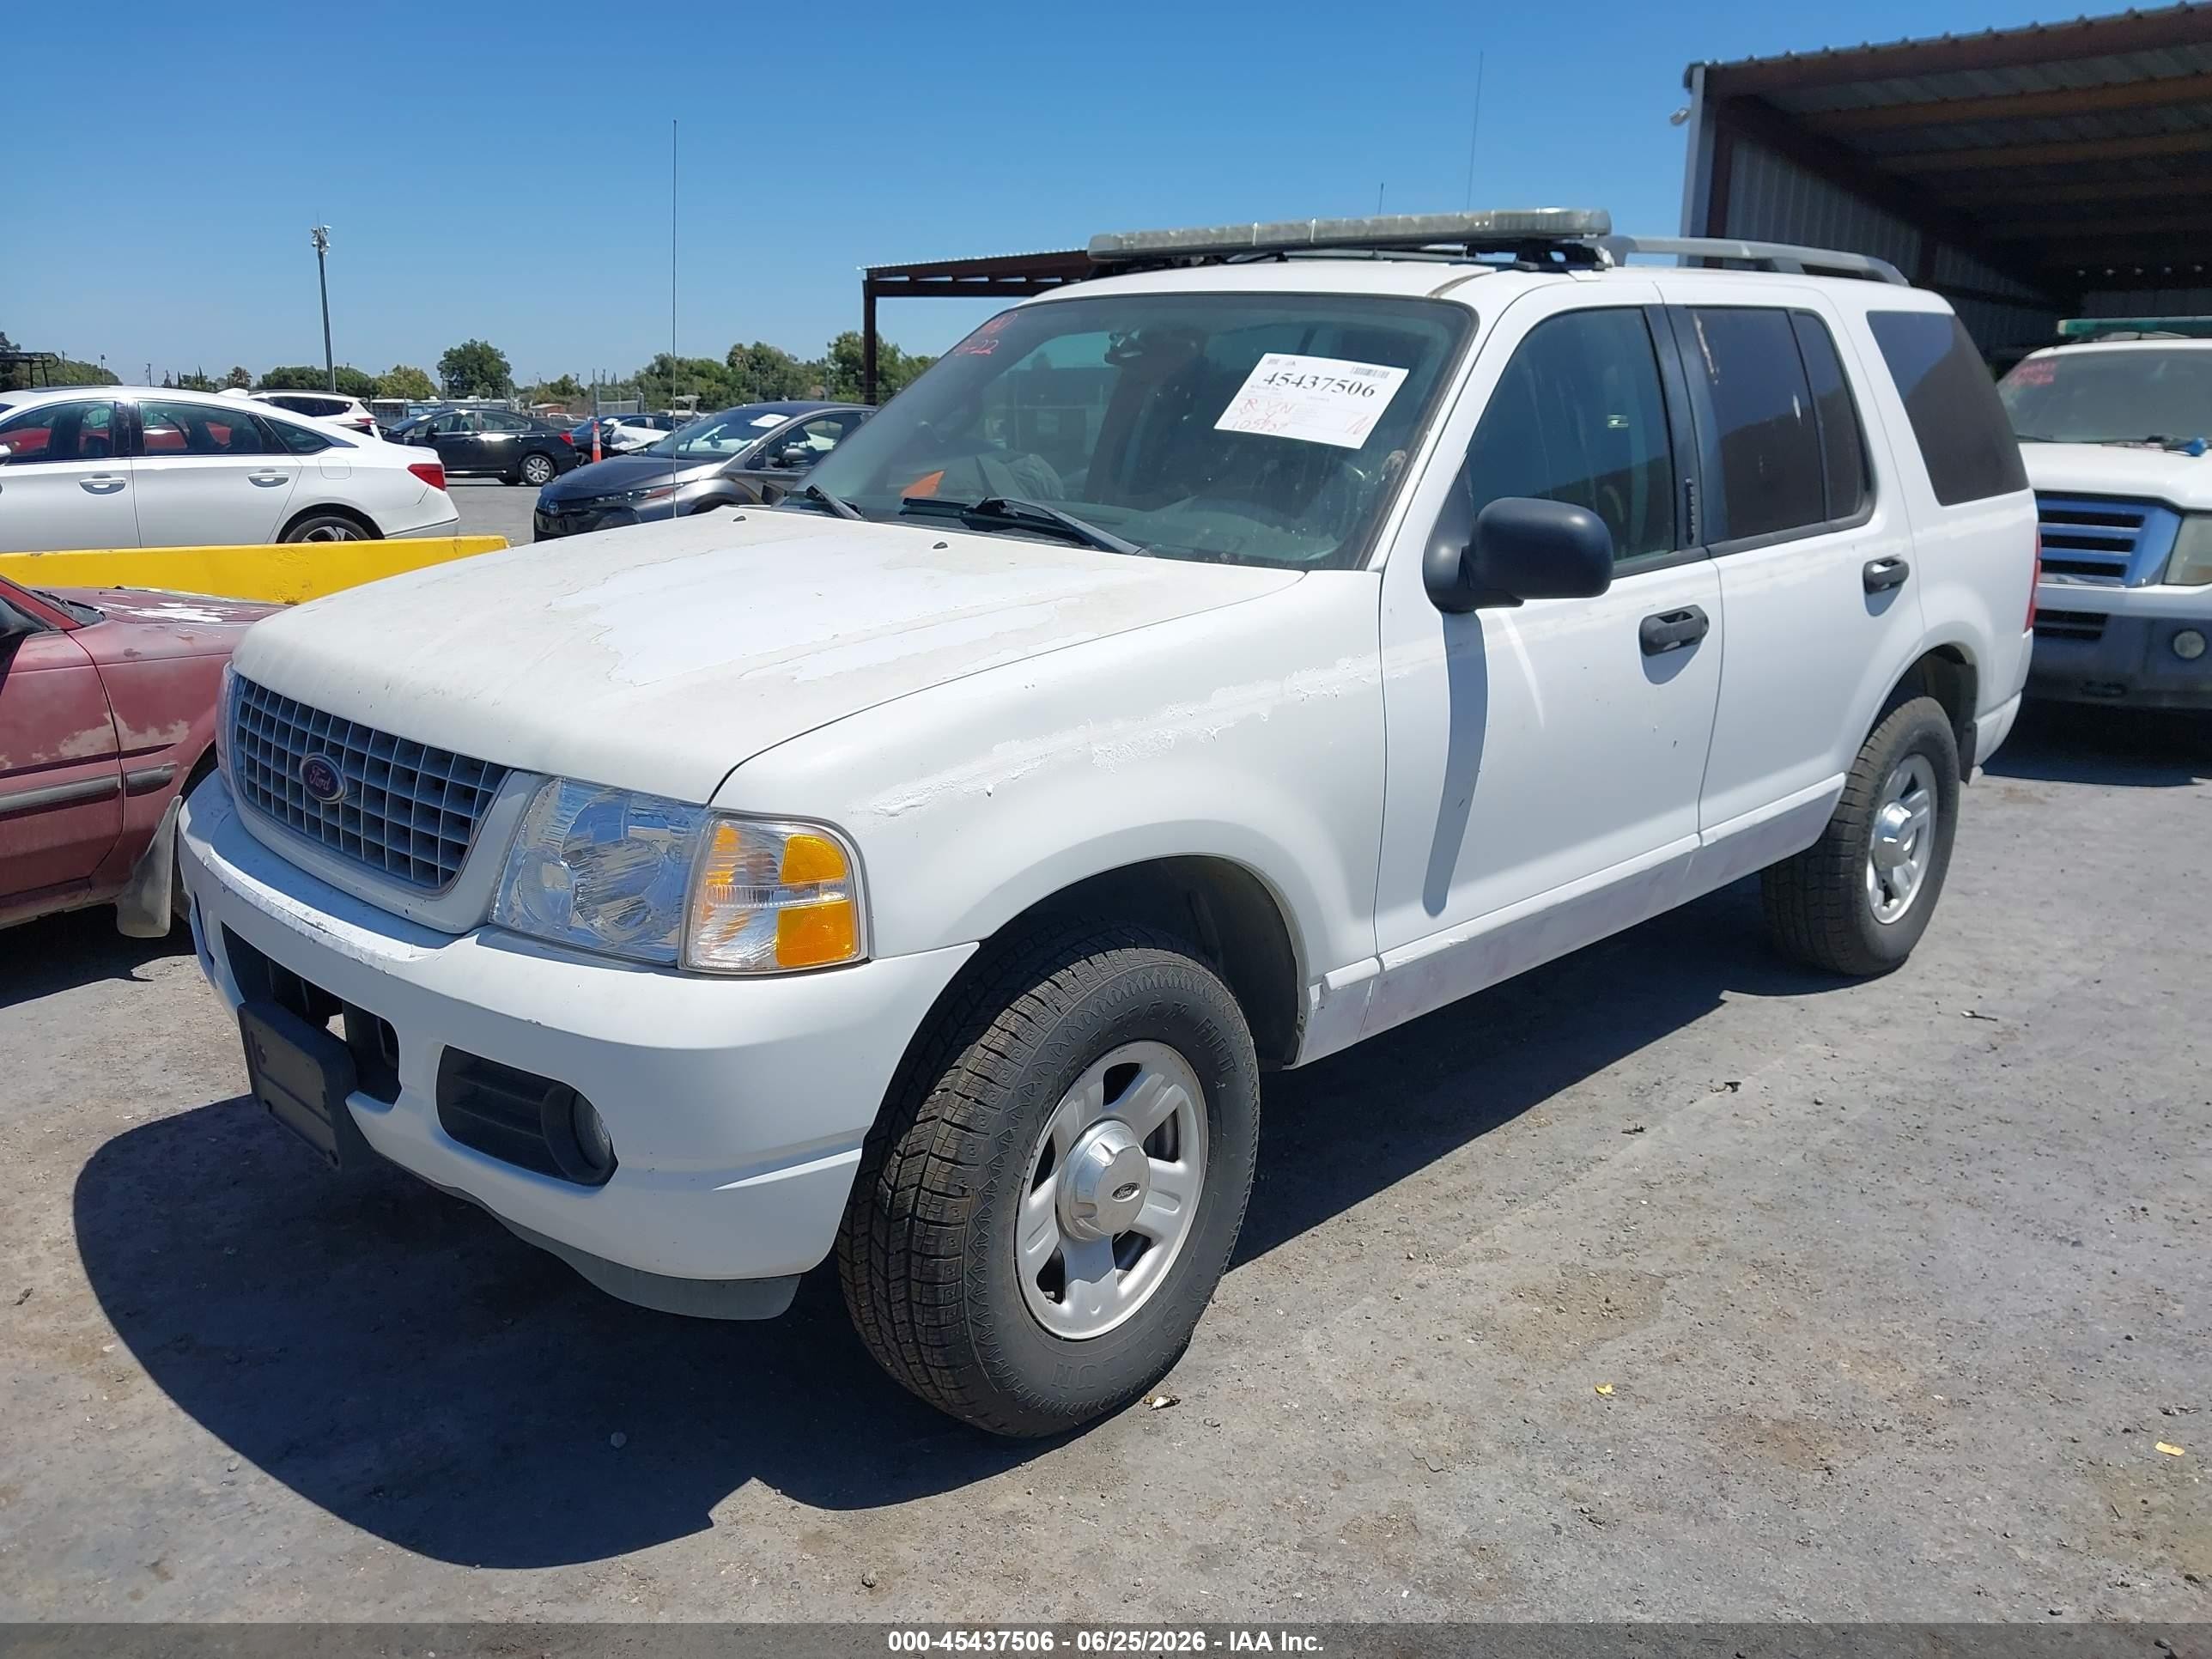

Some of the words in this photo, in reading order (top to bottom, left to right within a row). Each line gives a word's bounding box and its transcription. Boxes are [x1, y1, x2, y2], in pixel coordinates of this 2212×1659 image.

[1263, 371, 1377, 398] 45437506
[309, 764, 332, 791] Ford
[1116, 1185, 1134, 1198] Ford
